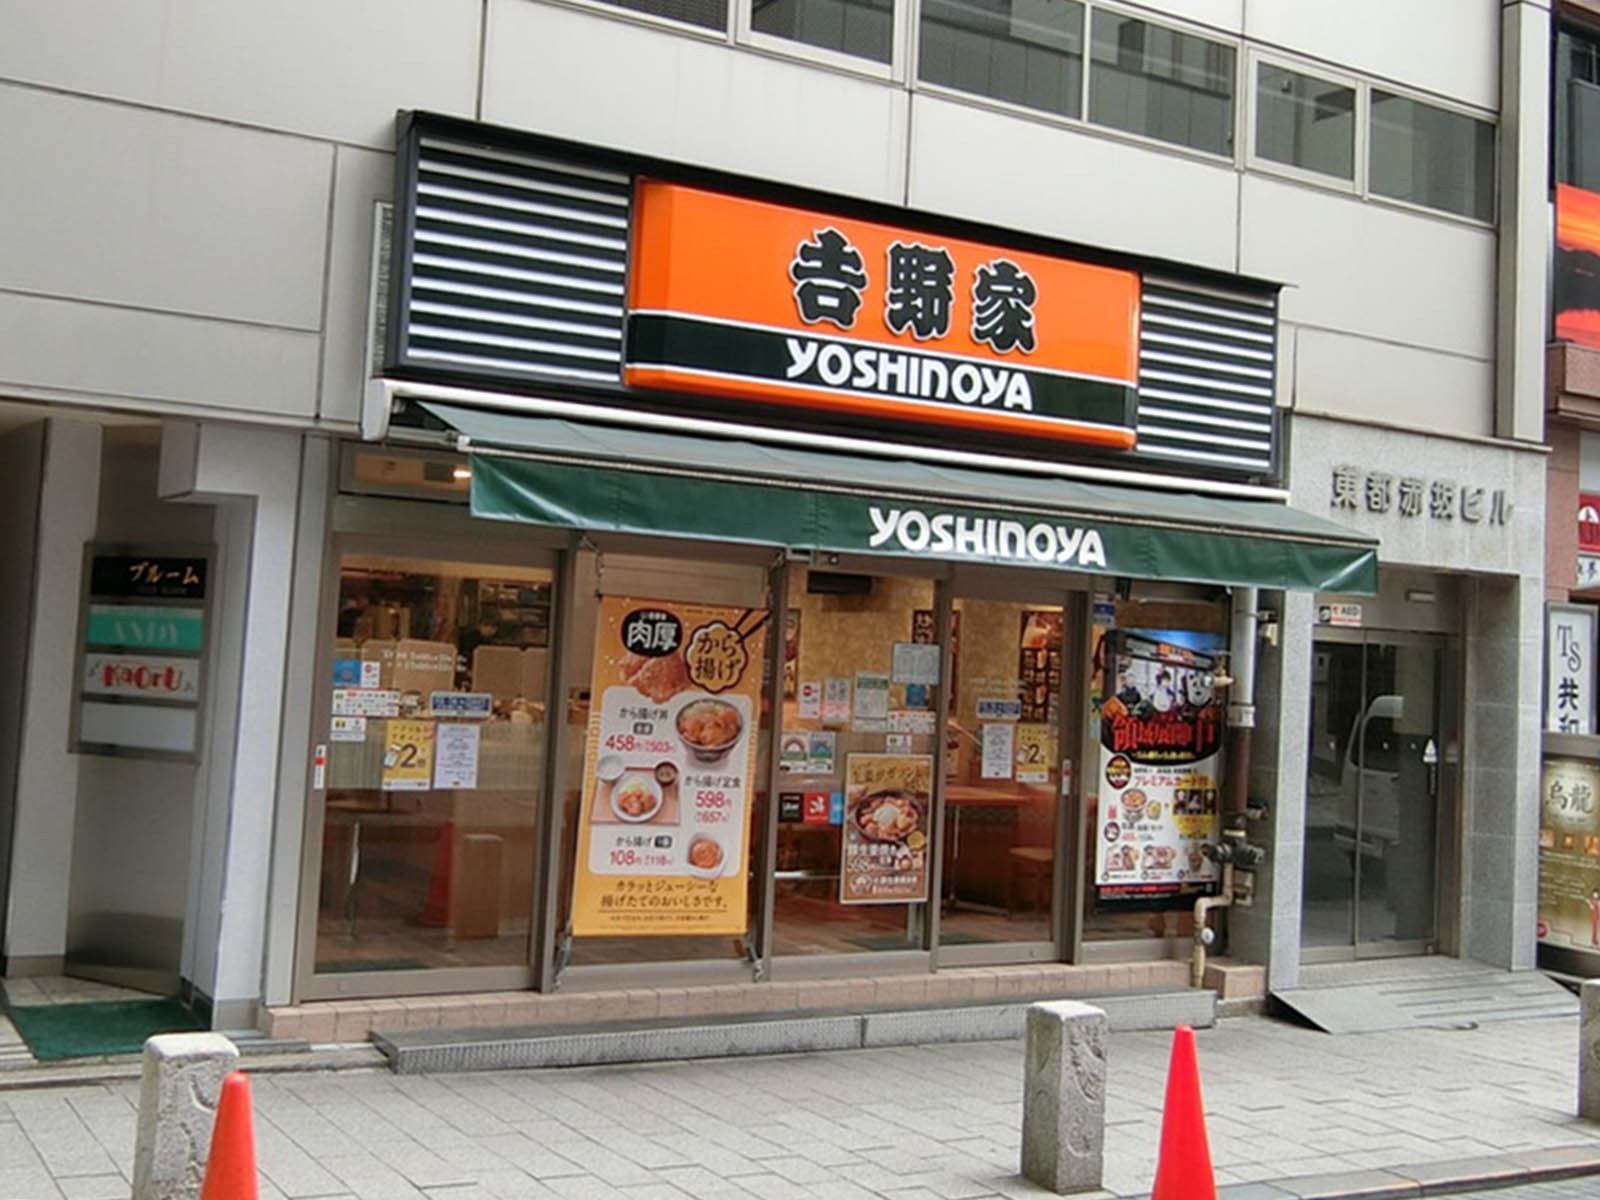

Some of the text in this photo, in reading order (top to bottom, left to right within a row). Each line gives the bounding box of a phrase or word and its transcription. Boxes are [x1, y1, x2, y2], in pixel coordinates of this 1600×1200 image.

[789, 226, 1037, 354] 吉野家
[786, 338, 1033, 411] YOSHINOYA
[1329, 465, 1514, 526] 東都赤坂ビル
[868, 507, 1107, 568] YOSHINOYA
[626, 620, 678, 650] 肉厚
